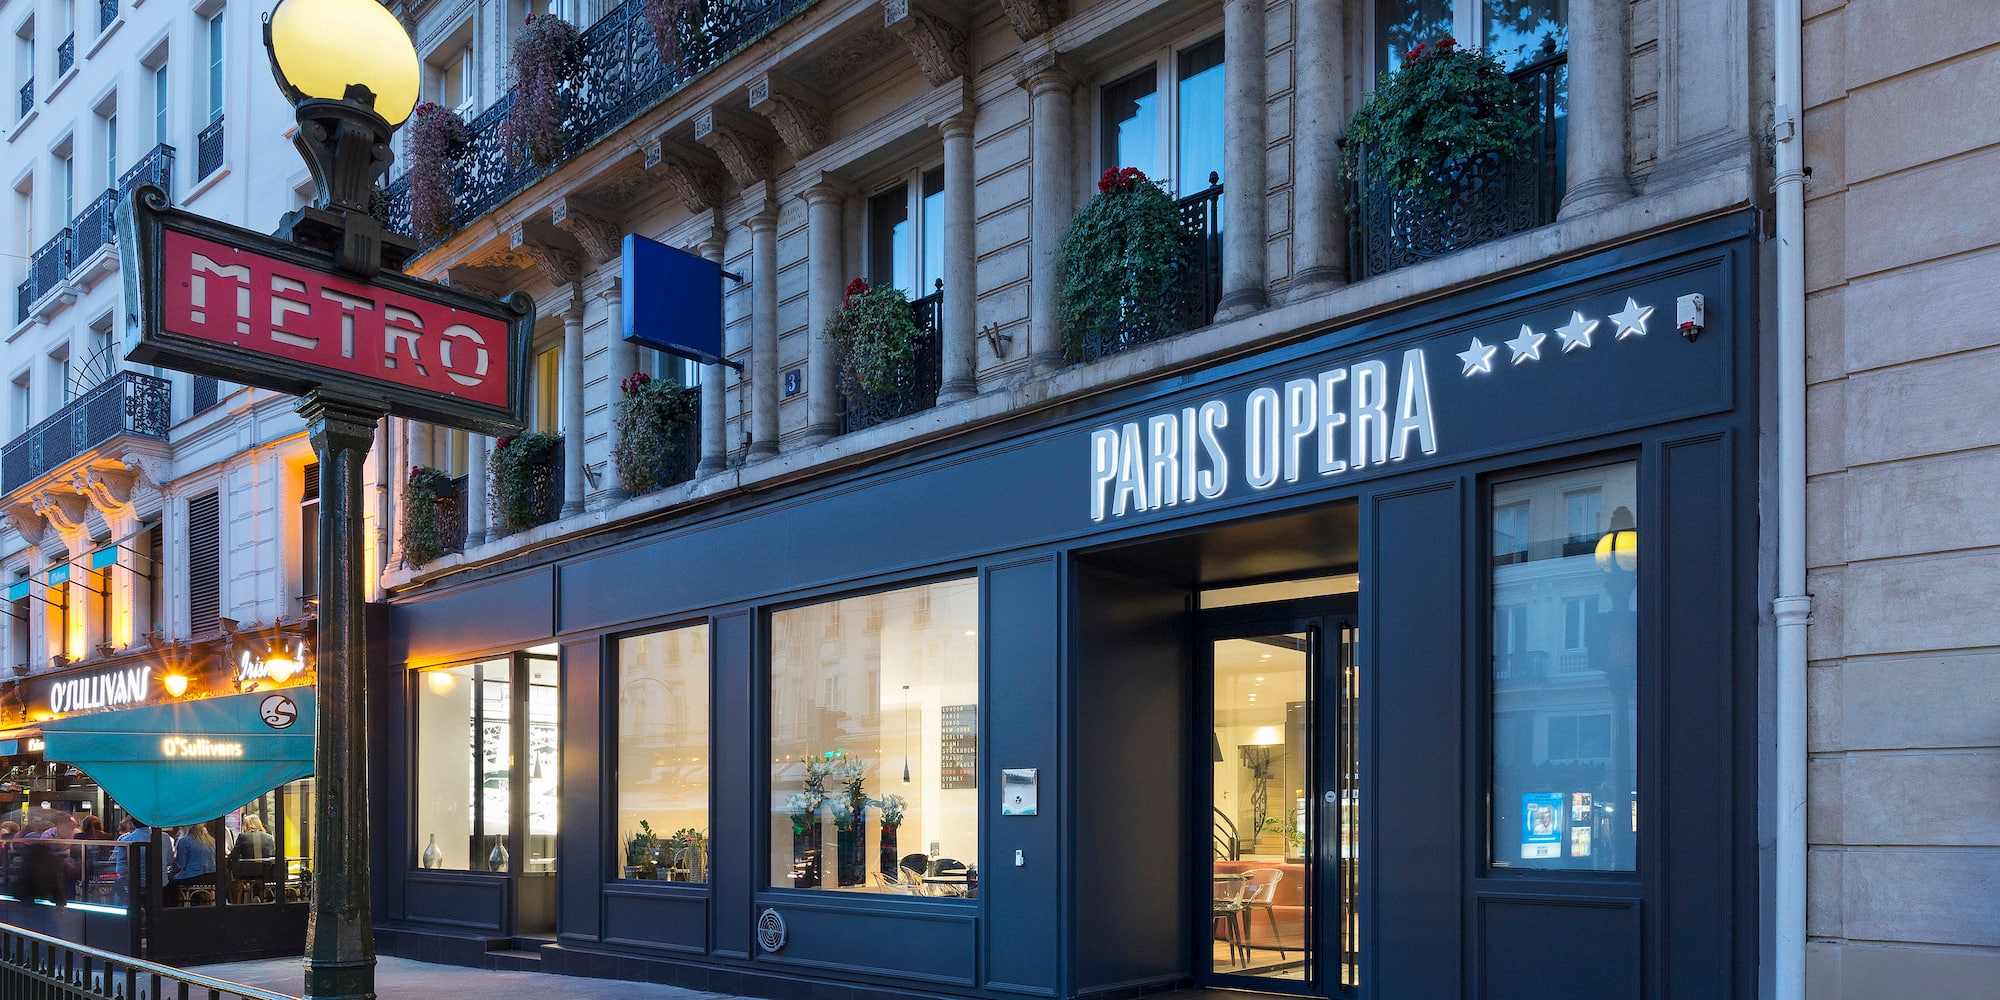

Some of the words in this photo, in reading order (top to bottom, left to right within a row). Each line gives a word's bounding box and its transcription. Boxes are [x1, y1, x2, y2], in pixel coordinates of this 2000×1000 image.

[190, 252, 489, 387] METRO
[788, 374, 796, 392] 3
[1090, 400, 1229, 521] PARIS
[1244, 347, 1438, 490] OPERA
[50, 665, 152, 714] O'SULLIVANS
[163, 736, 243, 757] O'Sullivans
